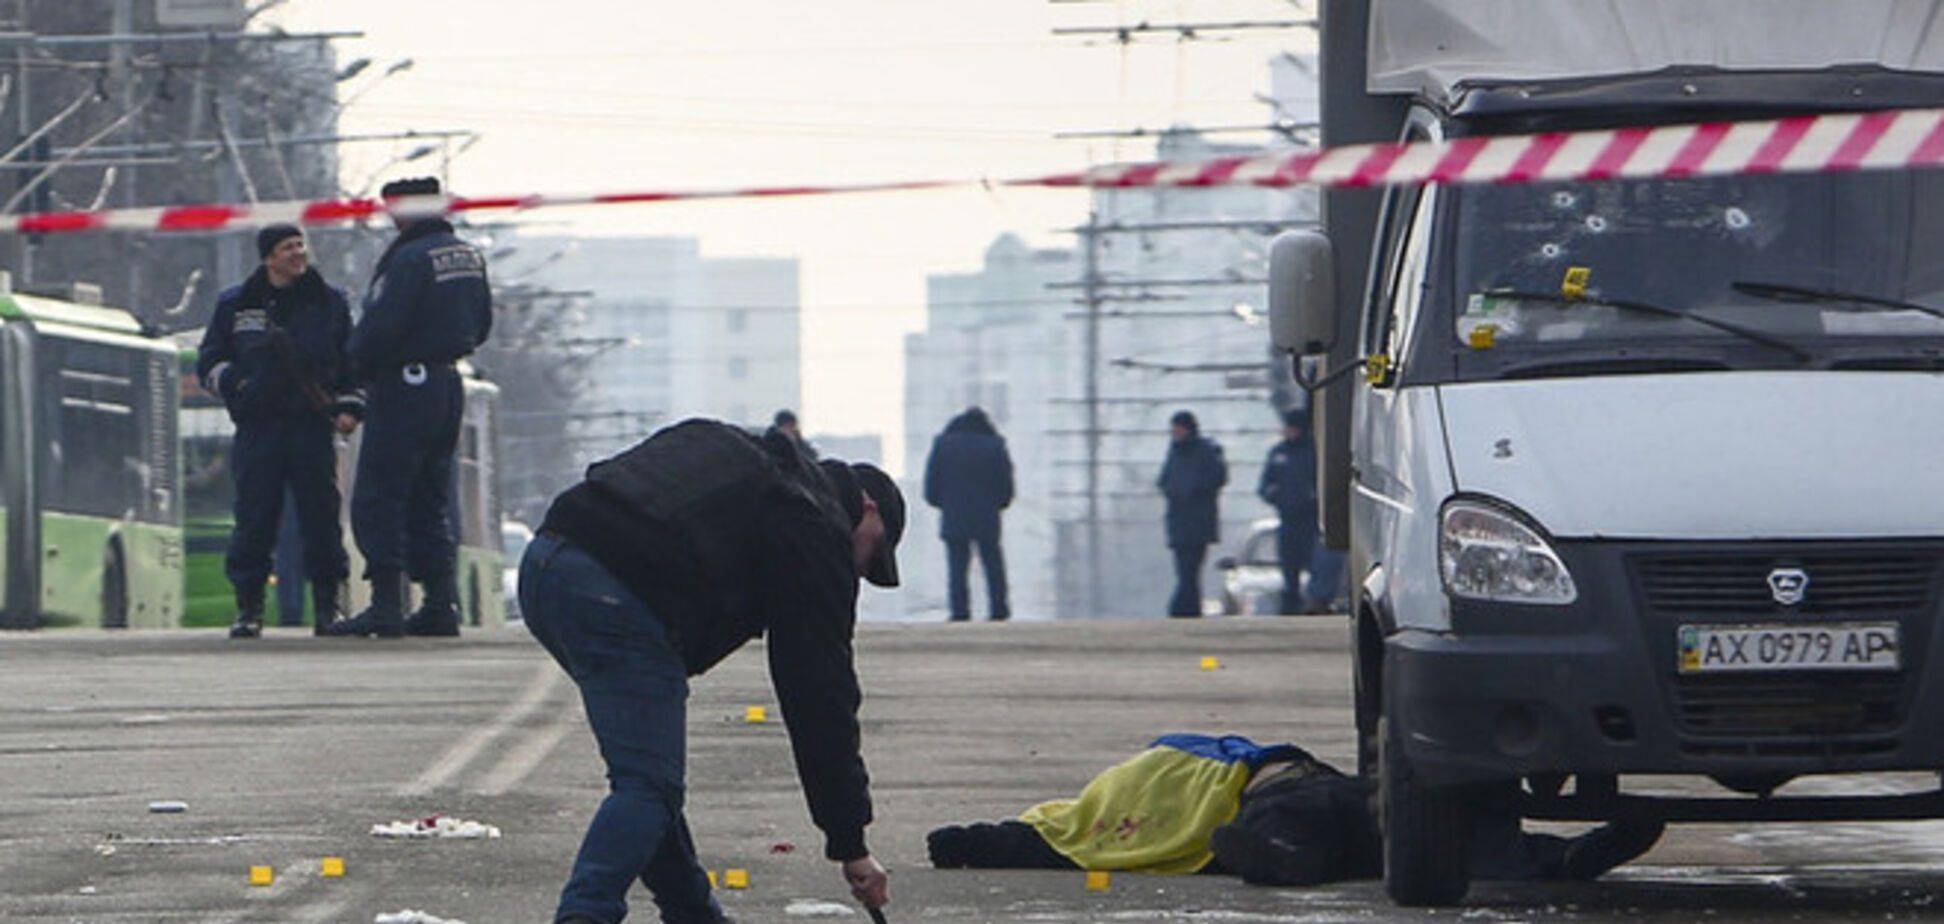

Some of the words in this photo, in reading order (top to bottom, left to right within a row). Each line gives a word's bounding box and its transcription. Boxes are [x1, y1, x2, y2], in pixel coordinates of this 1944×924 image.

[1704, 634, 1749, 664] AX
[1758, 632, 1833, 664] 0979
[1843, 632, 1887, 663] AP
